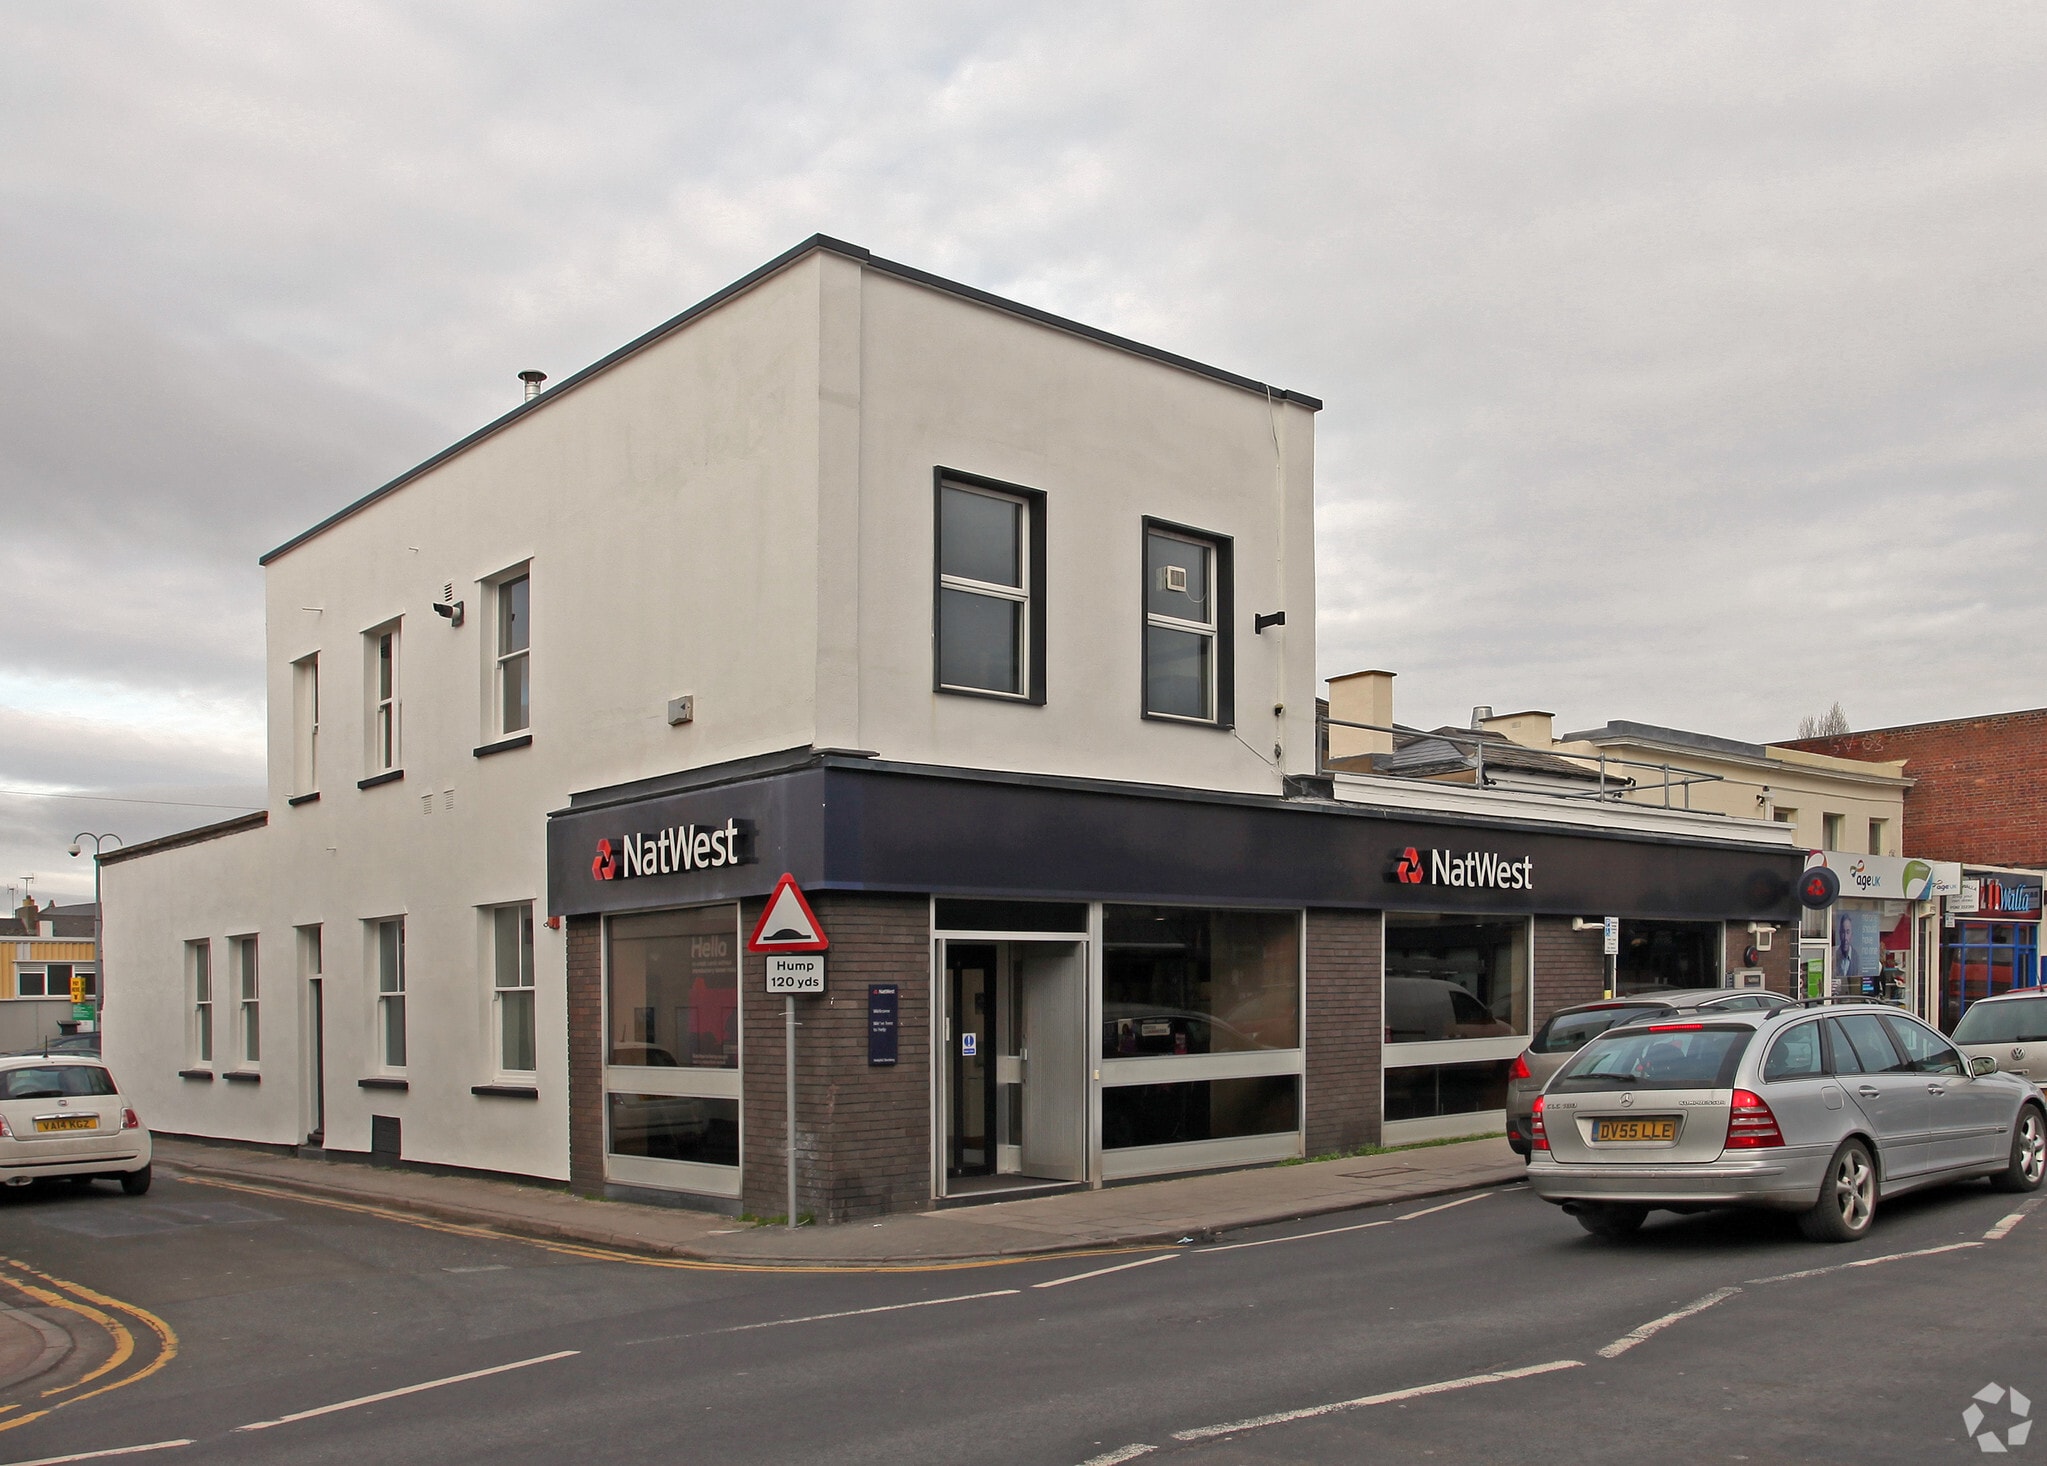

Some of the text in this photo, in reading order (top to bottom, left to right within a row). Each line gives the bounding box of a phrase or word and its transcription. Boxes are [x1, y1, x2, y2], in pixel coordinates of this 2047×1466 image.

[623, 817, 738, 878] NatWest
[1432, 848, 1533, 890] NatWest
[1999, 882, 2030, 912] Walla
[691, 935, 728, 958] Hello
[776, 961, 815, 973] Hump
[771, 977, 819, 989] 120 yds
[43, 1119, 90, 1130] VA14 KGZ
[1600, 1123, 1673, 1139] DV55 LLE
